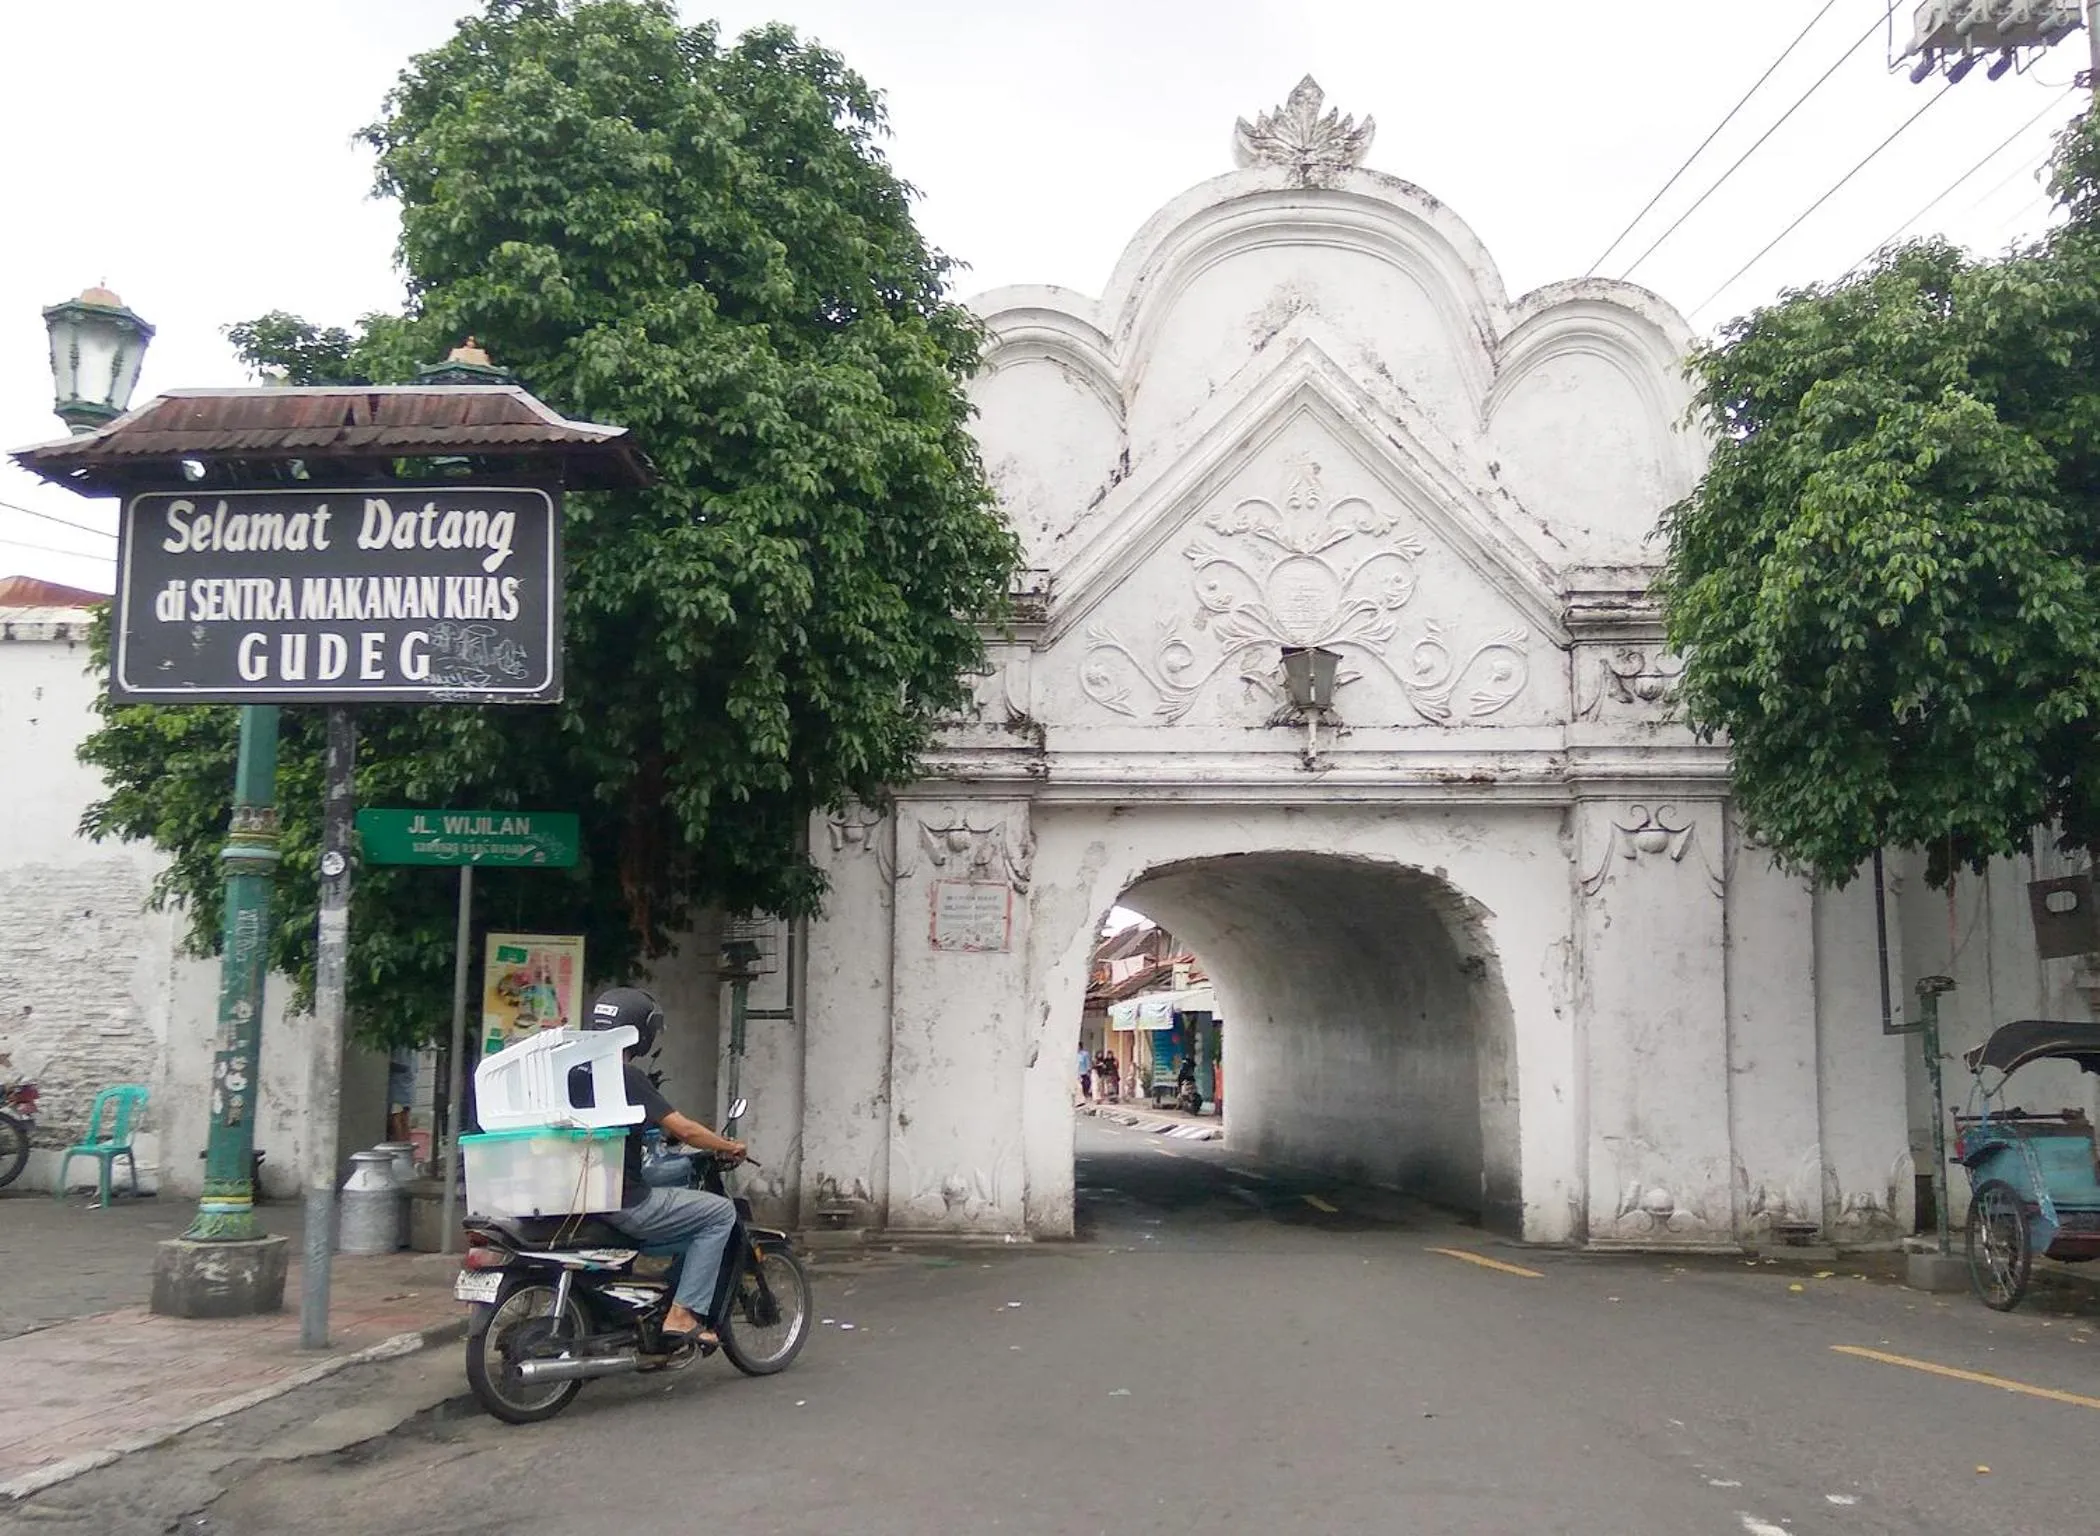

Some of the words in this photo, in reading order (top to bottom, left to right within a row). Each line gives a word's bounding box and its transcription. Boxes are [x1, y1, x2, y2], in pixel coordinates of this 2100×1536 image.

[163, 499, 332, 553] Selamat
[358, 498, 516, 573] Datang
[156, 579, 186, 622] di
[190, 577, 295, 622] SENTRA
[299, 576, 440, 620] MAKANAN
[444, 576, 520, 621] KHAS
[237, 631, 431, 681] GUDEG
[443, 815, 531, 836] WIJILAN
